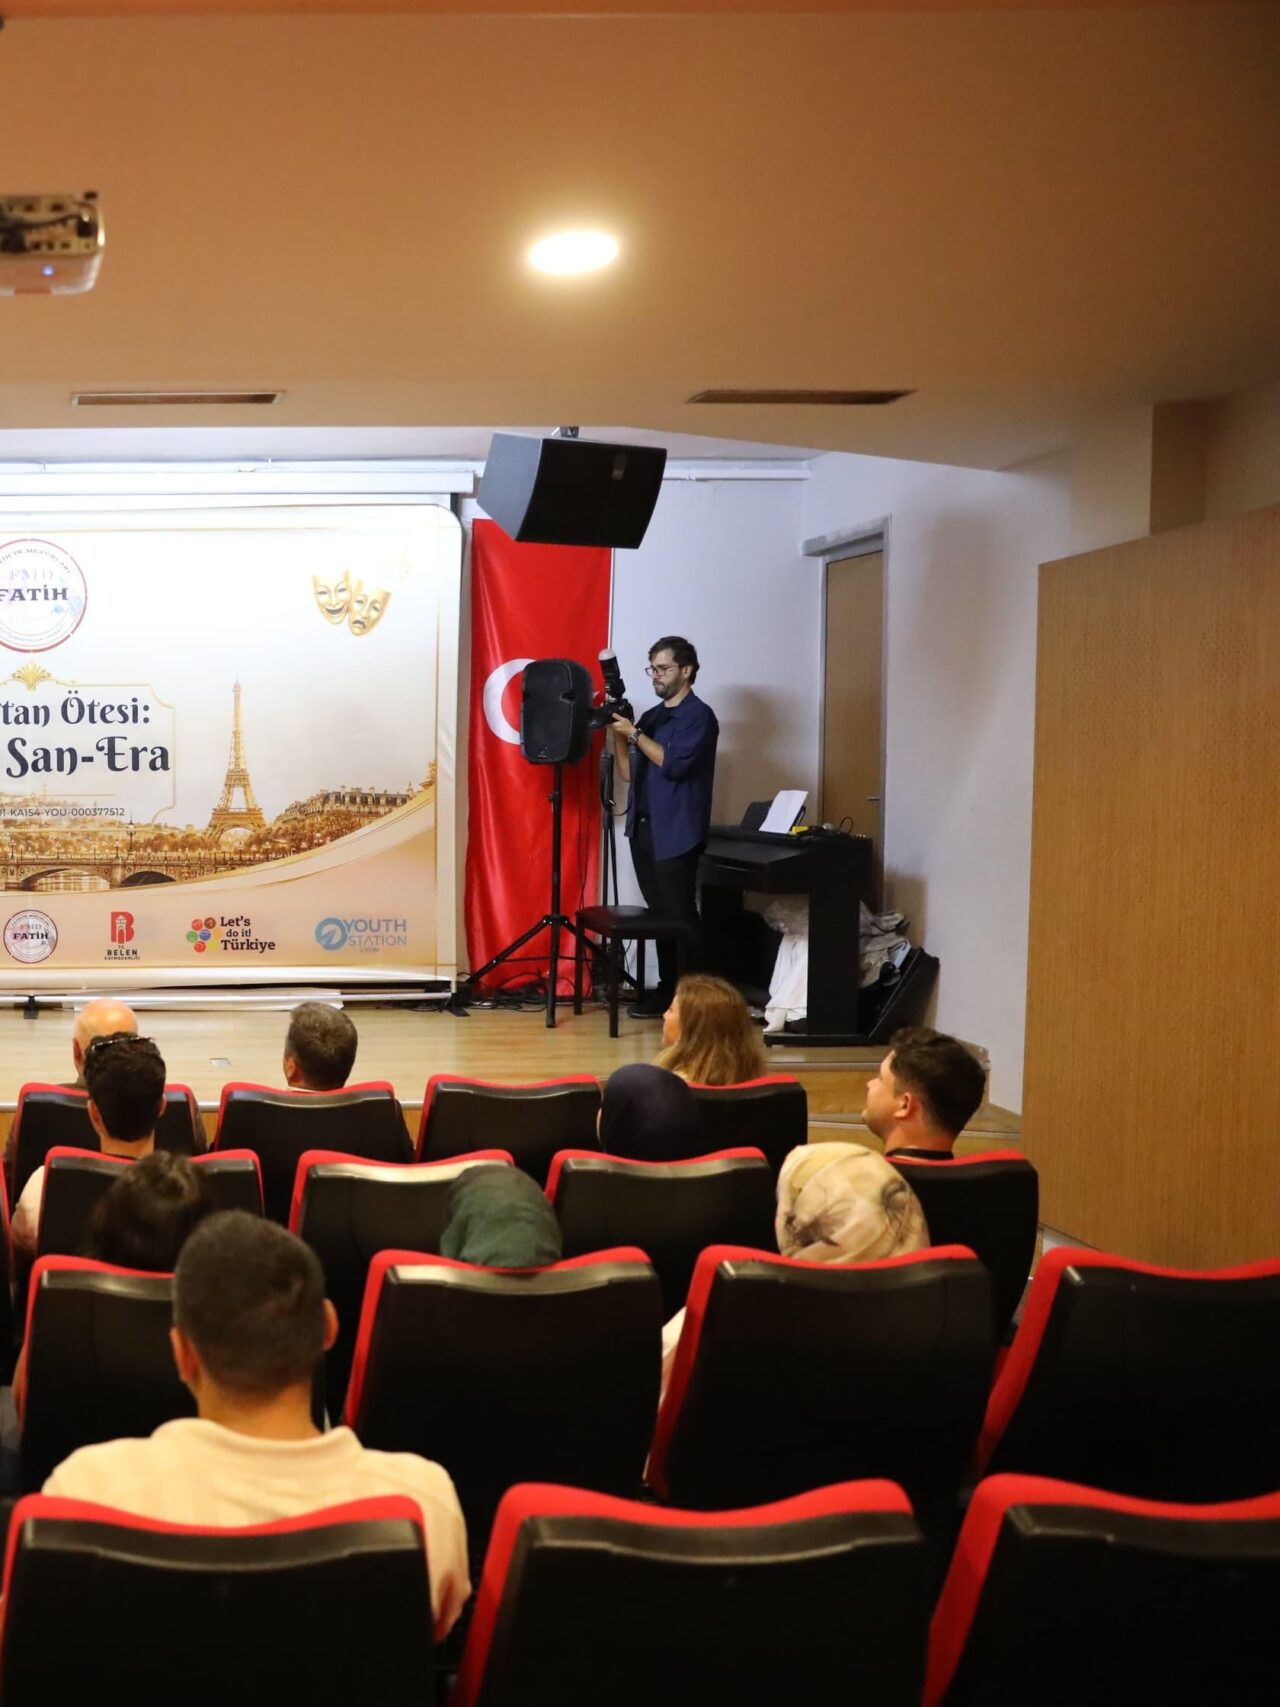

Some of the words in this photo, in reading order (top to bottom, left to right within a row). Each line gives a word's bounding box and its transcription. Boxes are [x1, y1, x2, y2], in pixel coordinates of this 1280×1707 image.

[60, 690, 150, 725] Ötesi:
[5, 736, 170, 779] San-Era
[343, 919, 407, 932] YOUTH
[13, 931, 48, 940] FATİH
[226, 929, 239, 938] do
[241, 929, 252, 938] it!
[220, 939, 276, 954] Türkiye
[348, 935, 407, 946] STATION
